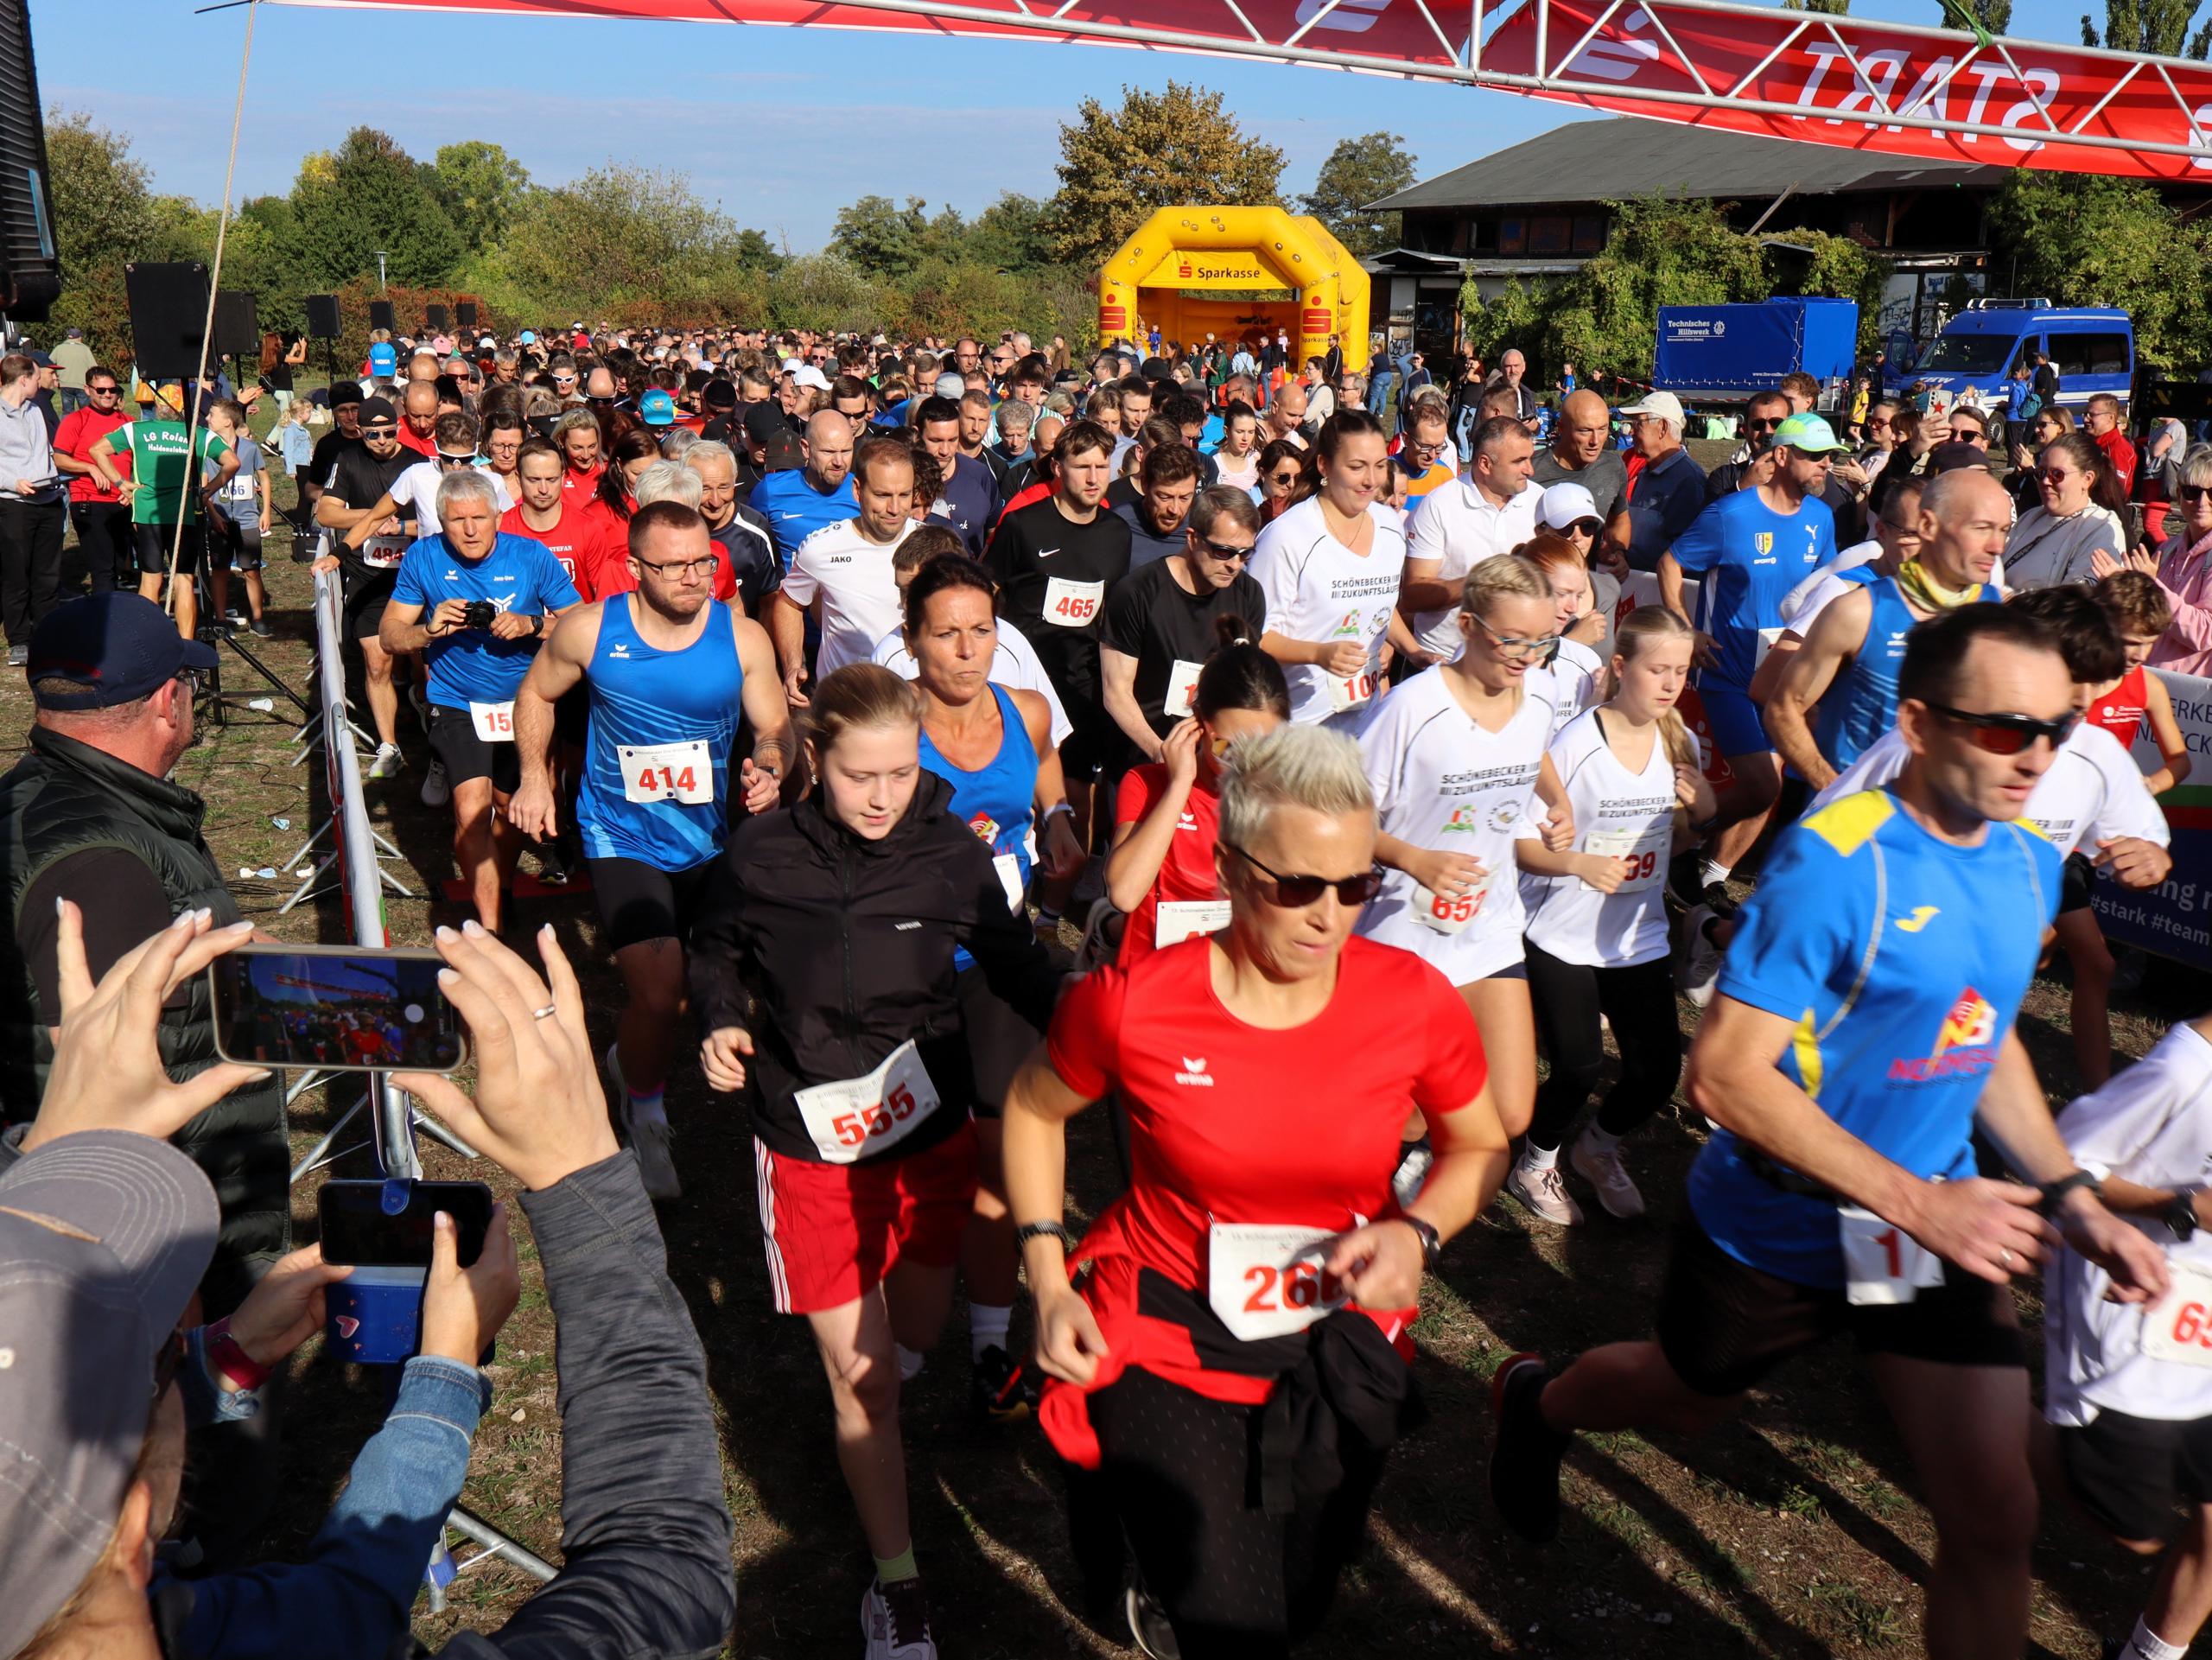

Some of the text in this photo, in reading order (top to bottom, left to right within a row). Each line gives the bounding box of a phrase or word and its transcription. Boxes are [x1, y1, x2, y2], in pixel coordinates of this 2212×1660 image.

[1198, 267, 1260, 279] Sparkasse
[143, 431, 188, 444] LG Rolan
[372, 546, 403, 562] 484
[1332, 576, 1391, 588] SCHÖNEBECKER
[1056, 596, 1095, 618] 465
[1344, 670, 1378, 701] 108
[639, 766, 696, 792] 414
[1441, 764, 1526, 784] SCHÖNEBECKER
[1599, 797, 1666, 808] SCHÖNEBECKER
[2090, 894, 2146, 926] #stark
[831, 1081, 916, 1146] 555
